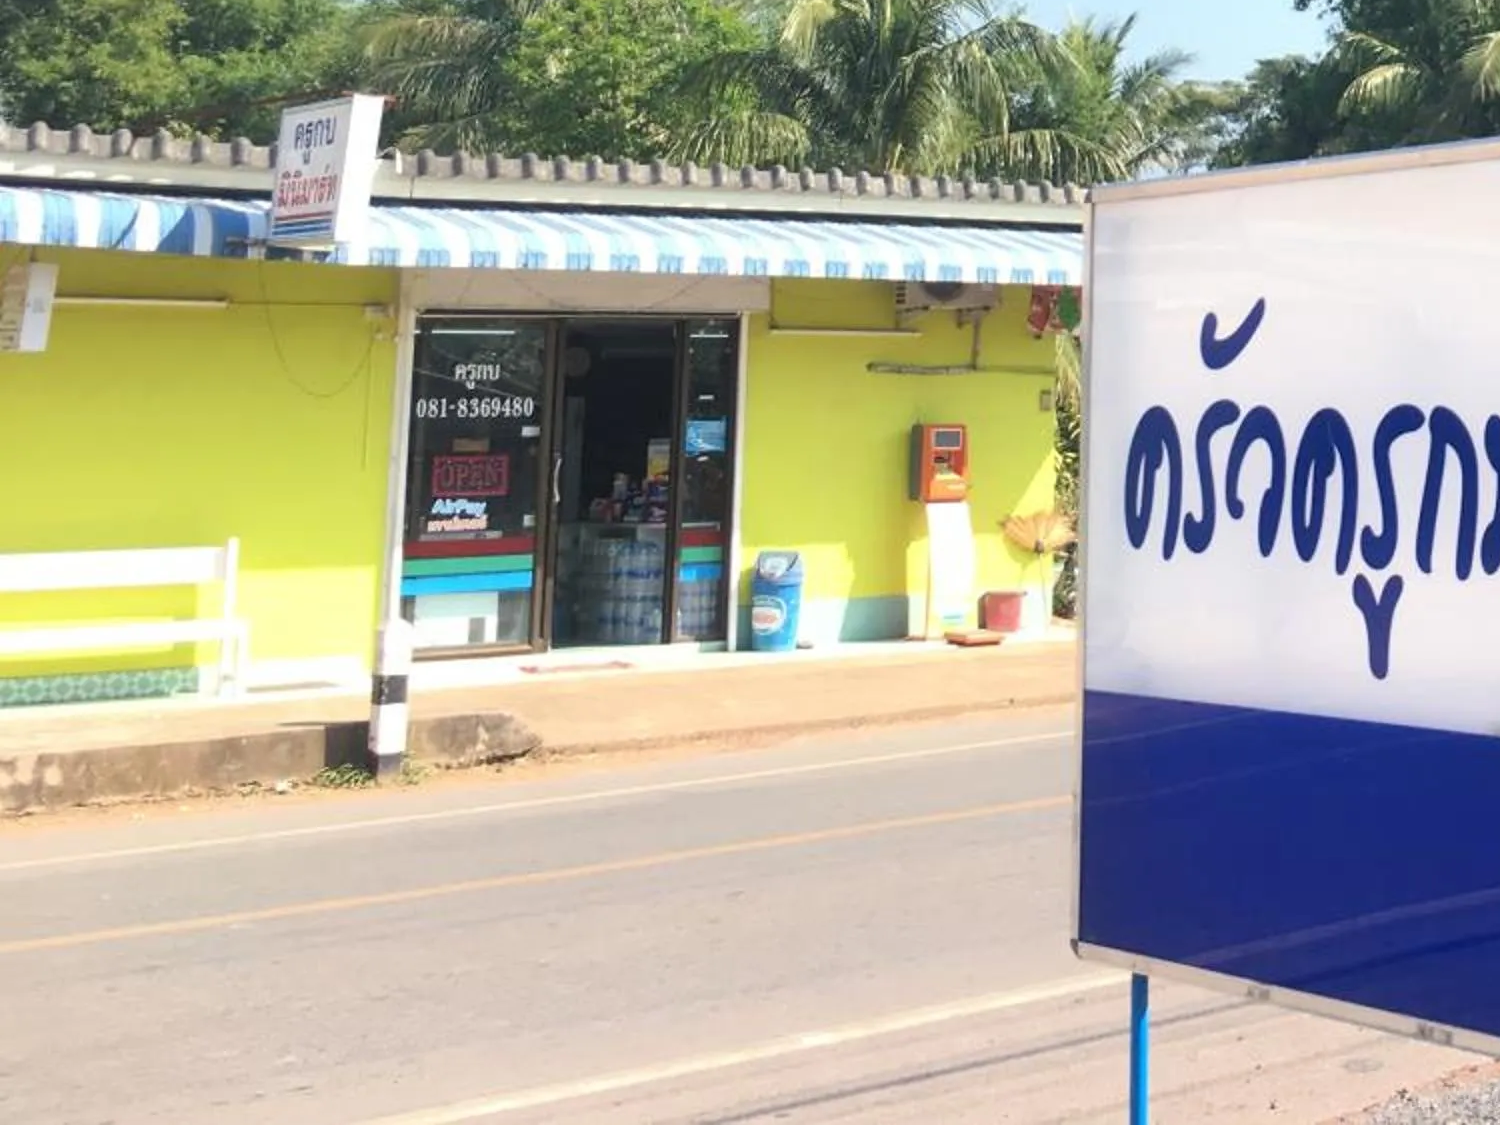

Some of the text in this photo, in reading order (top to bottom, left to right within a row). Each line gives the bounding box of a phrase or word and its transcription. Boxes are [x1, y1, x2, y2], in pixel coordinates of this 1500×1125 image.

[295, 115, 337, 165] ครูกบ
[454, 363, 501, 390] ครูกบ
[416, 397, 534, 418] 081-8369480
[440, 462, 500, 491] OPEN
